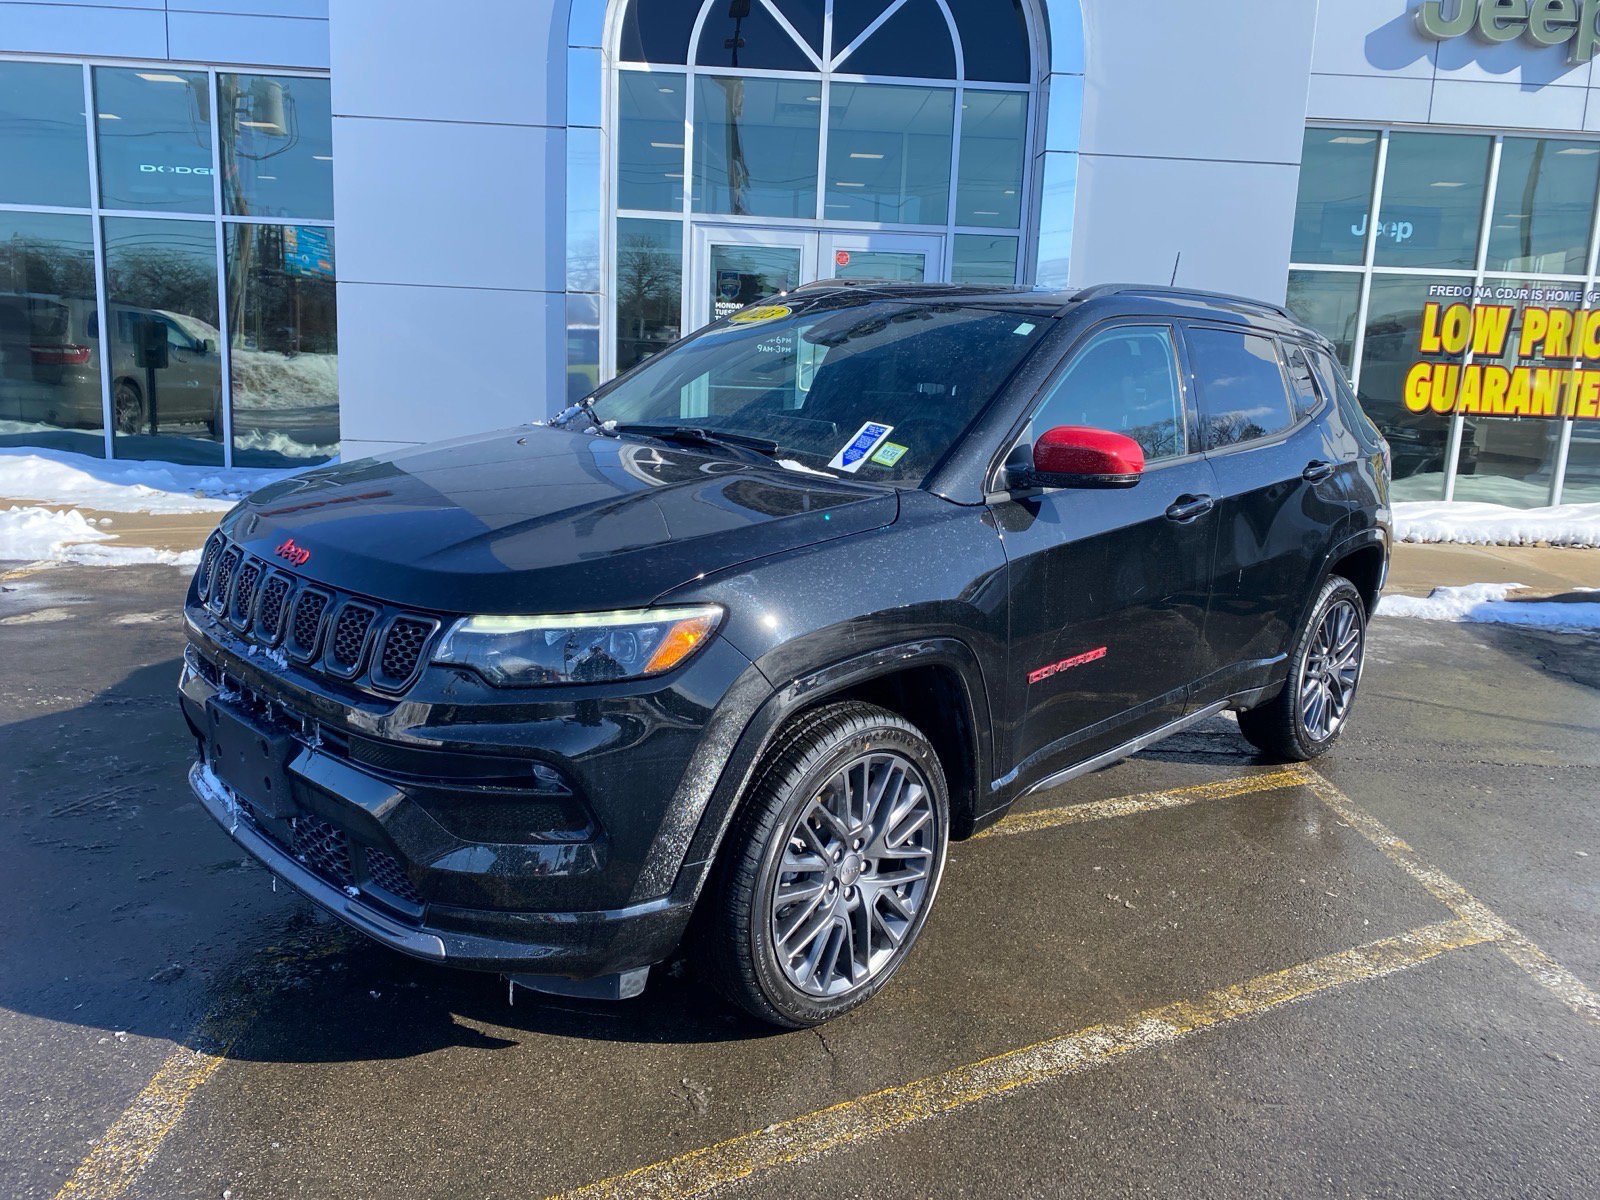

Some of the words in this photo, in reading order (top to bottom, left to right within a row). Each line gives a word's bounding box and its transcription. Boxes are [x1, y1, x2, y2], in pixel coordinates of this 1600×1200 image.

[140, 164, 214, 175] DODG
[1495, 288, 1529, 300] CDJR
[1531, 290, 1543, 301] IS
[1545, 290, 1583, 302] HOME
[715, 302, 745, 310] MONDAY
[1419, 301, 1516, 358] LOW
[756, 343, 792, 354] 9AM-3PM
[274, 538, 310, 567] Jeep
